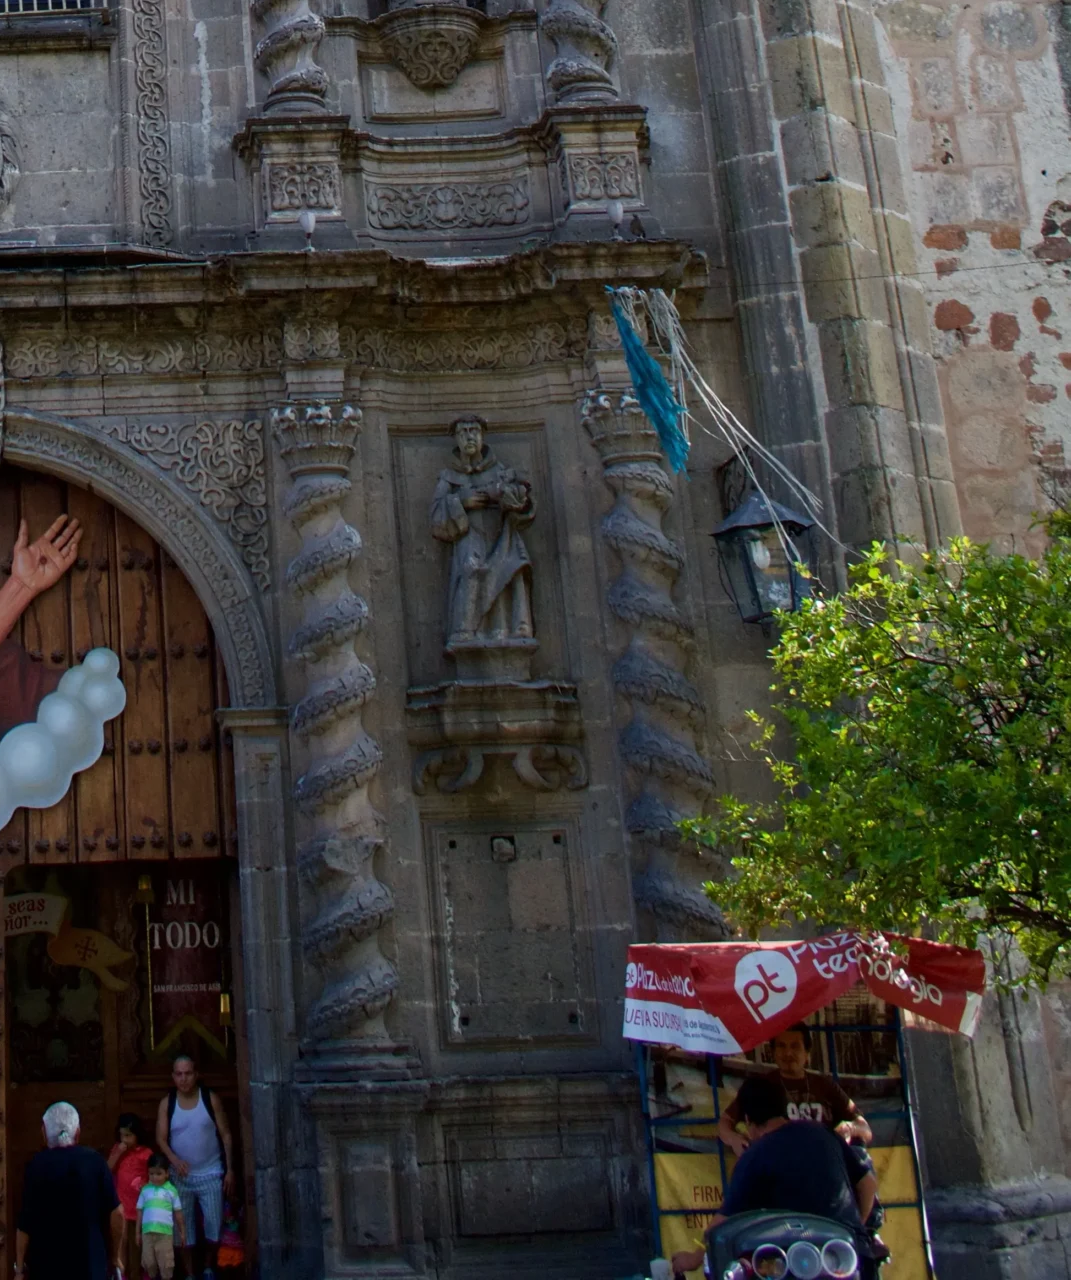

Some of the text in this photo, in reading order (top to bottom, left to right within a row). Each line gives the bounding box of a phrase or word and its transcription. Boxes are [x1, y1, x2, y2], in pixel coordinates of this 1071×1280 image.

[166, 879, 196, 905] MI
[8, 898, 45, 914] seas
[149, 920, 220, 950] TODO
